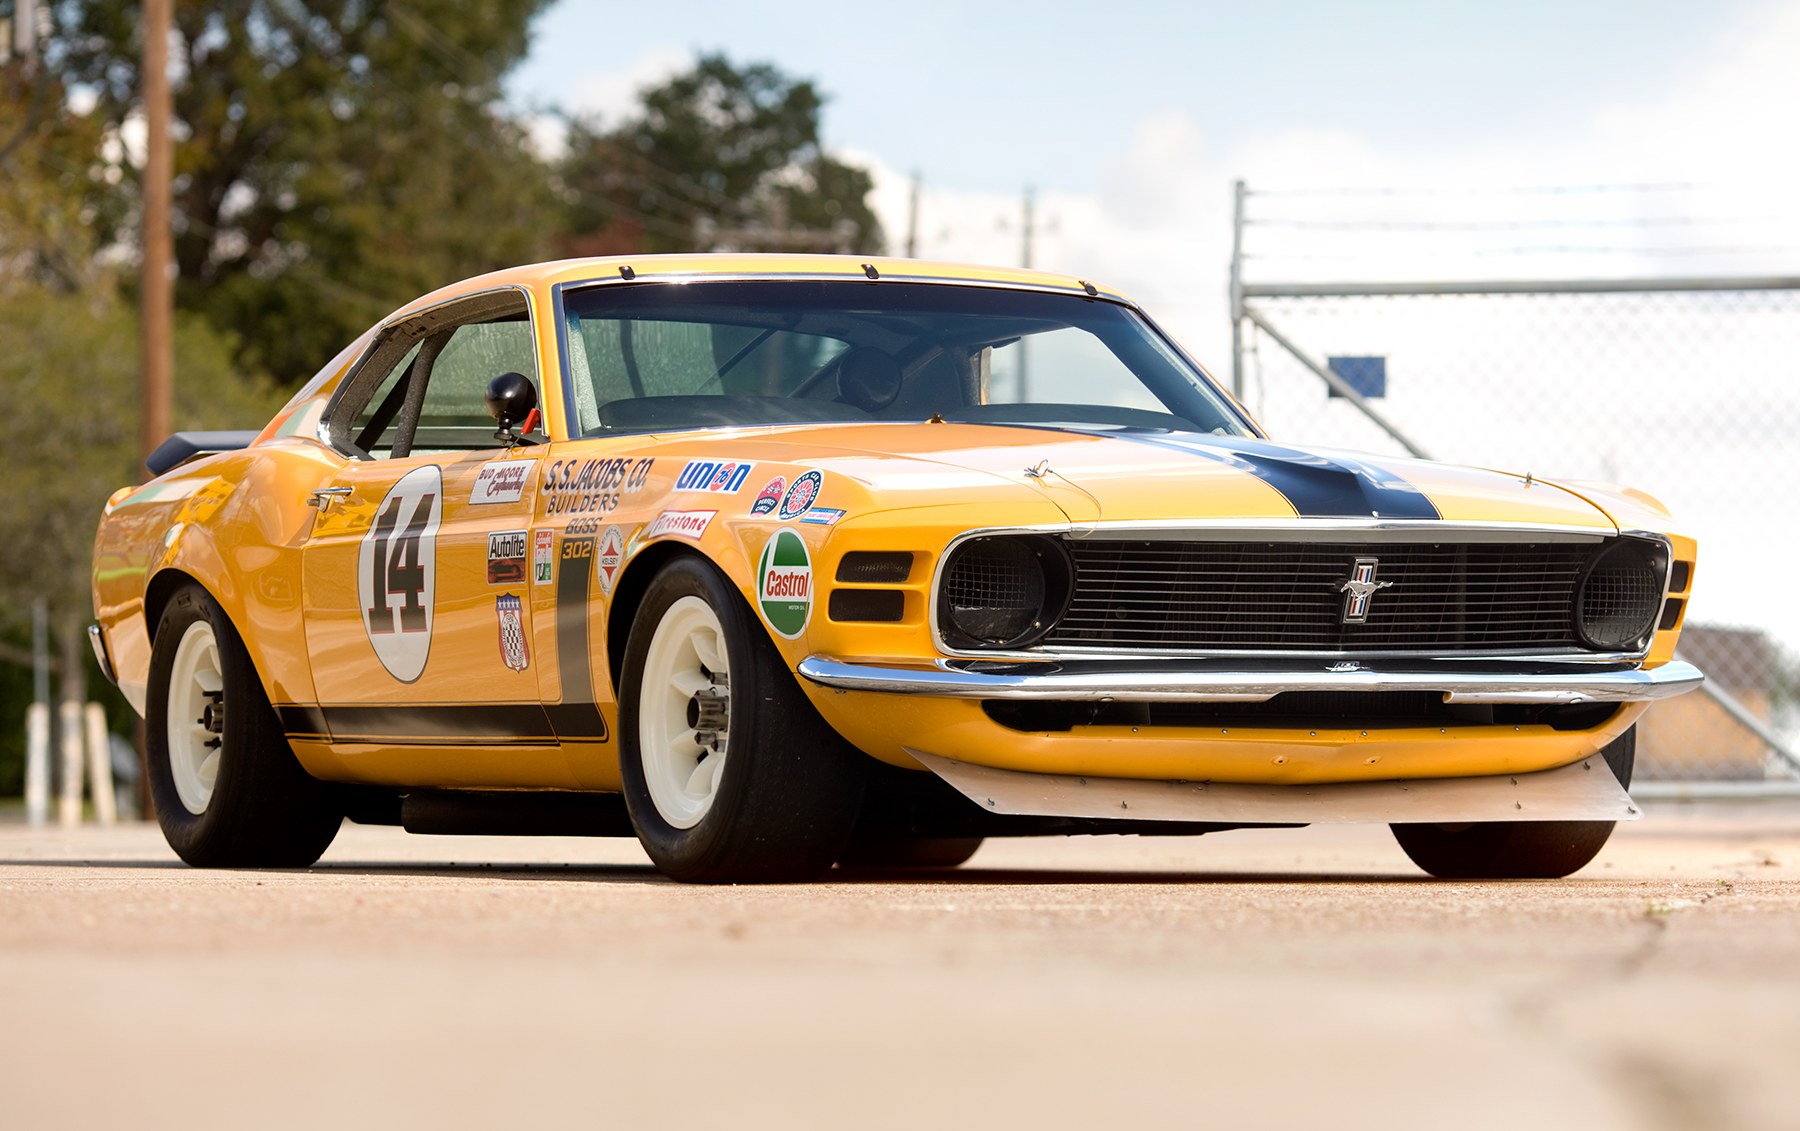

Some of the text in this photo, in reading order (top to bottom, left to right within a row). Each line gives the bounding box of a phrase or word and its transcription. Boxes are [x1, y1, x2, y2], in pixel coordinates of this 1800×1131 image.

[479, 466, 526, 480] BUD MOORE
[715, 468, 731, 484] 76
[810, 472, 819, 482] CAR
[547, 493, 620, 514] BUILDERS
[755, 504, 770, 512] CIRCLE
[757, 498, 776, 506] PERFECT
[565, 517, 603, 535] BOSS
[654, 514, 707, 532] Firestone
[489, 534, 526, 559] Autolite
[562, 541, 591, 560] 302
[368, 493, 435, 635] 14
[766, 570, 810, 597] Castrol
